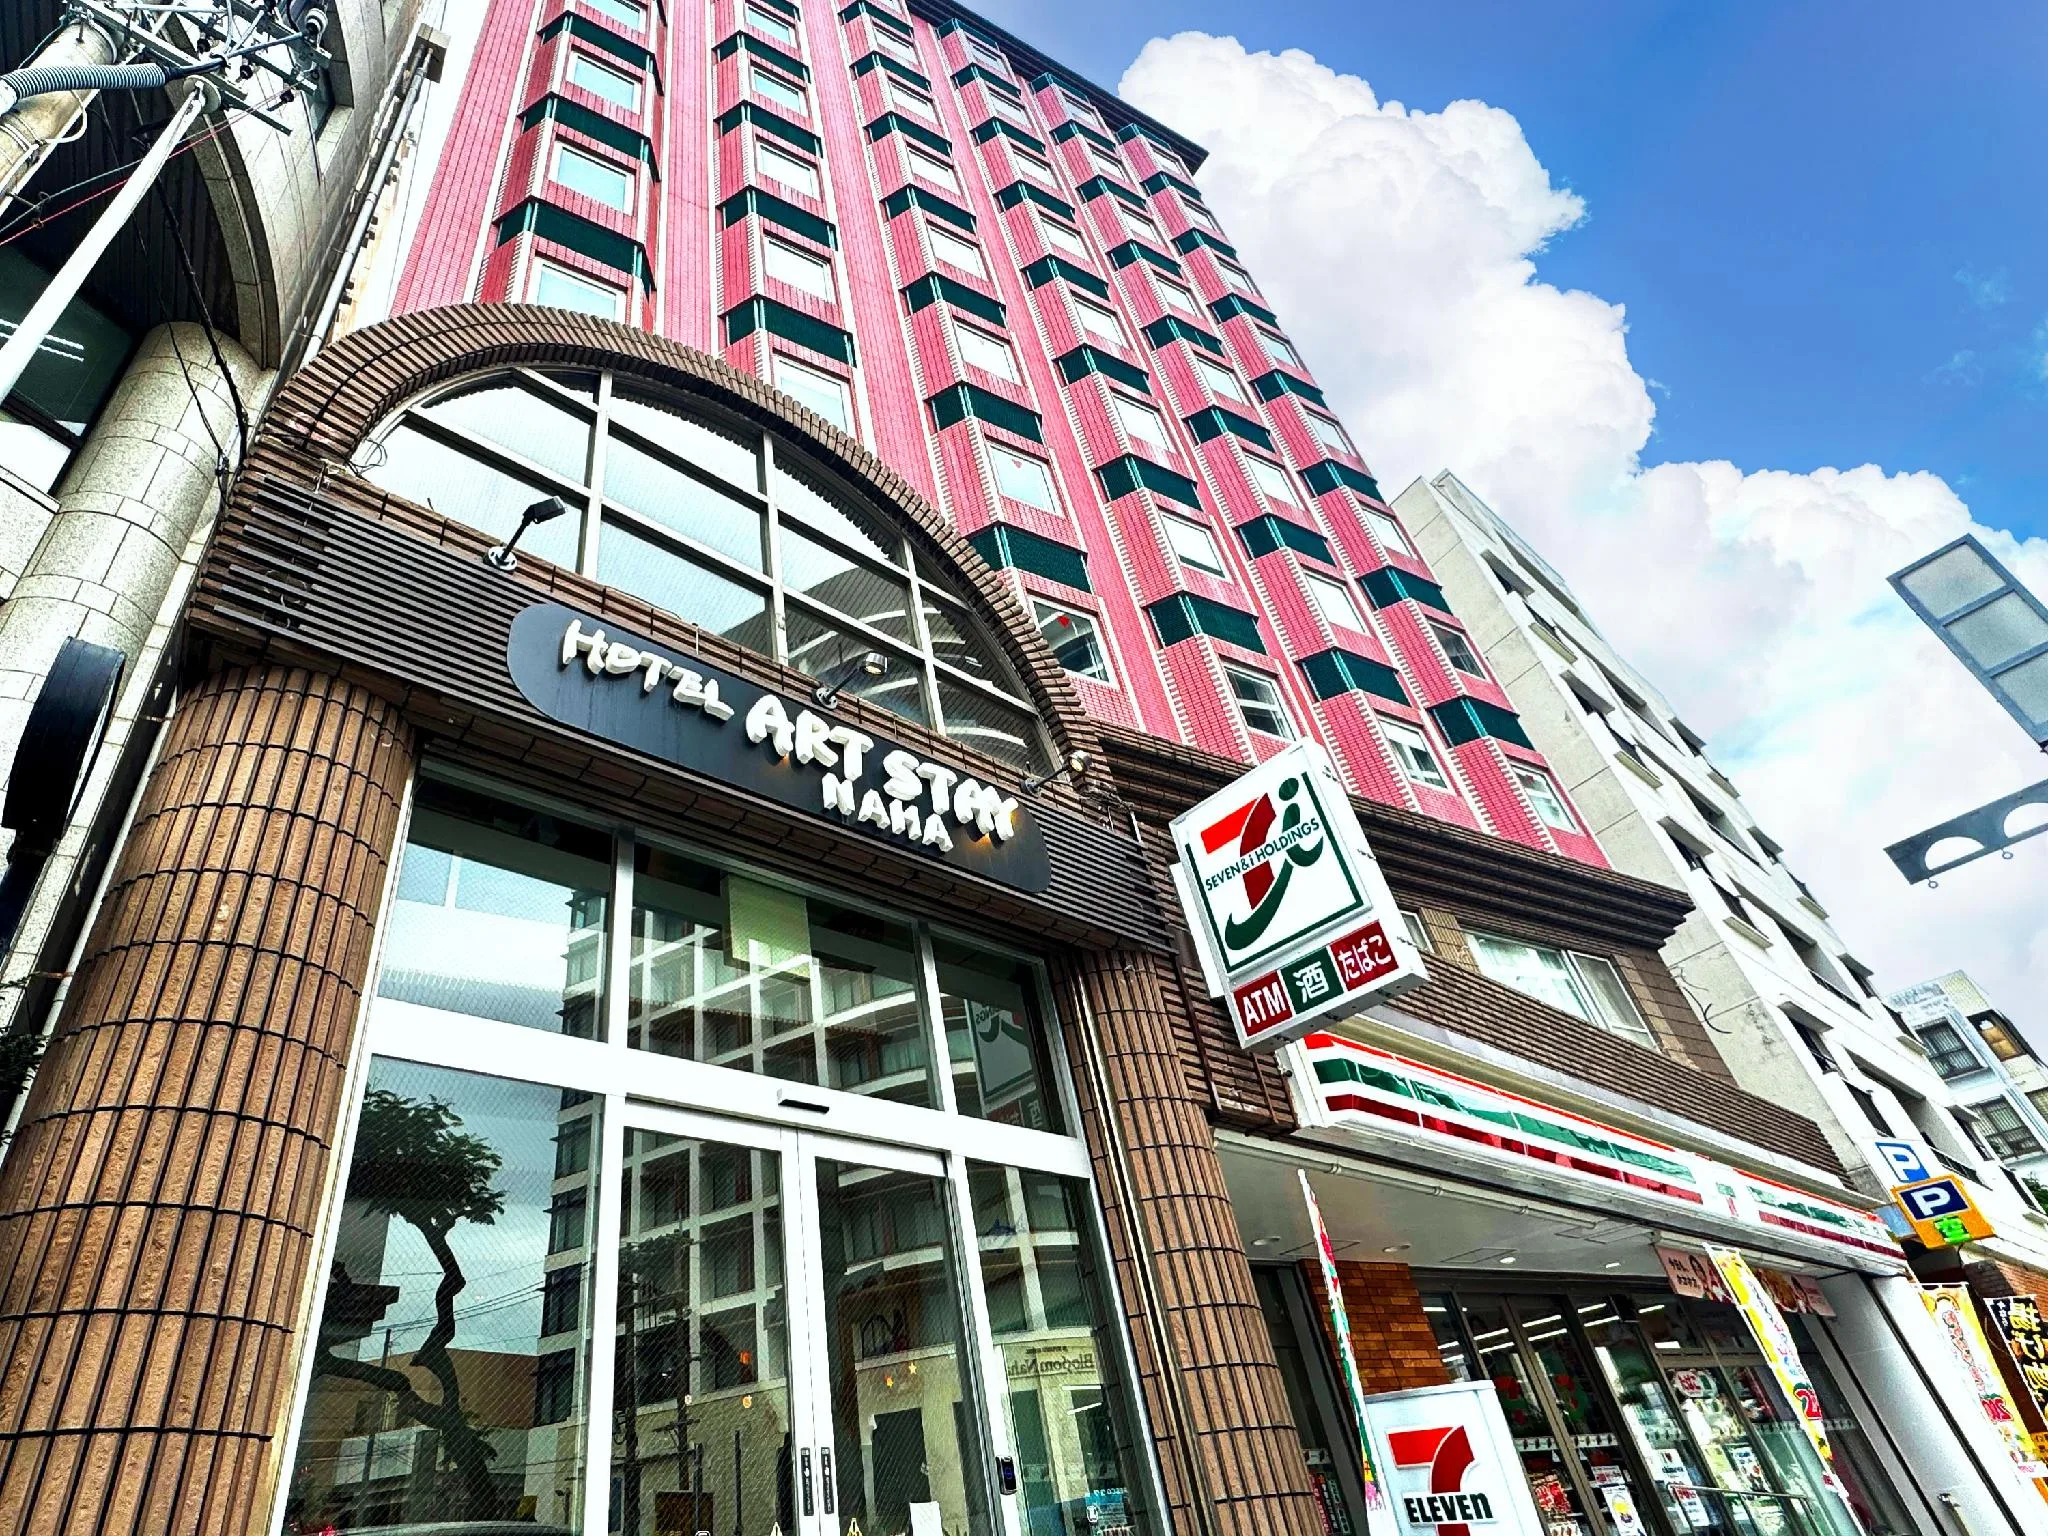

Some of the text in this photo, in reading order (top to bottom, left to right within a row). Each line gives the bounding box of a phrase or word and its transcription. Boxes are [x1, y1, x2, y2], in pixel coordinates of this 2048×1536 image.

[562, 618, 1018, 841] HOTEL ART STAY
[822, 772, 953, 852] NAHA
[1255, 817, 1320, 864] HOLDINGS
[1337, 934, 1392, 981] たばこ
[1245, 981, 1287, 1028] ATM
[1291, 960, 1329, 1003] 酒
[1911, 1186, 1951, 1216] P
